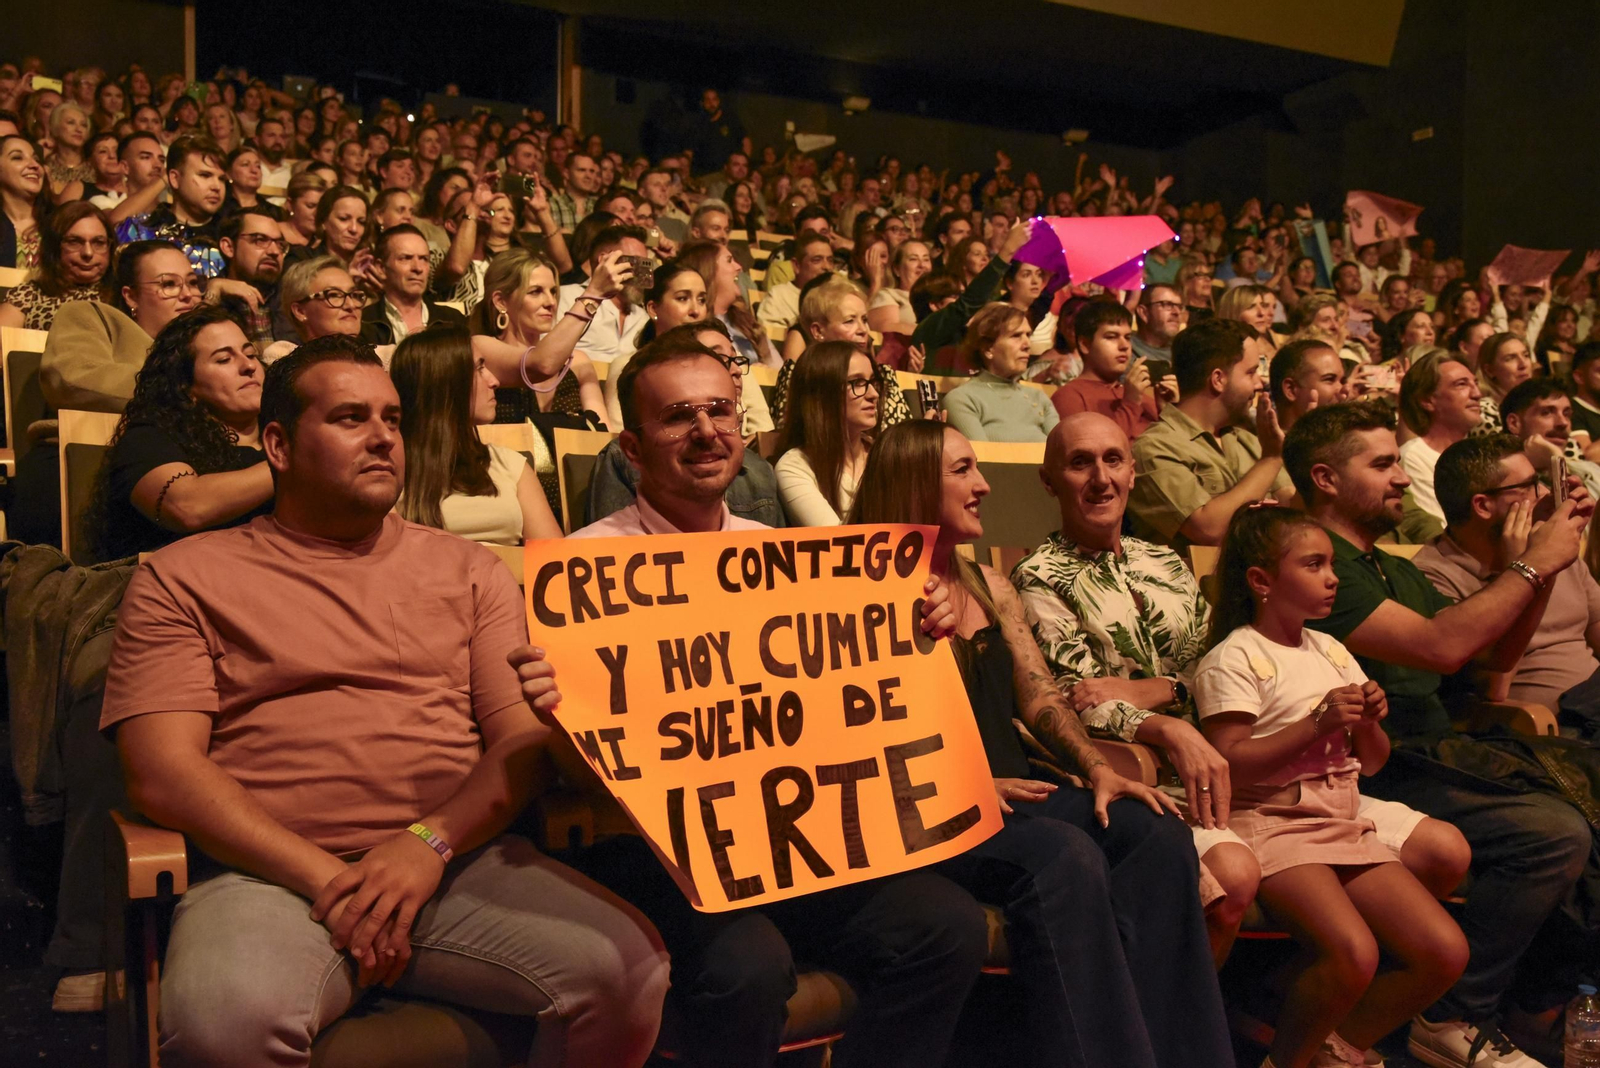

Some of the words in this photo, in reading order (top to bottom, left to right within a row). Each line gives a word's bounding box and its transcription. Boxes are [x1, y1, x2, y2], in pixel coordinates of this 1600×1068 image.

[532, 551, 689, 628] CRECI
[716, 530, 924, 593] CONTIGO
[595, 644, 628, 715] Y
[657, 631, 736, 693] HOY
[758, 597, 937, 679] CUMPLO
[573, 727, 642, 781] MI
[657, 682, 804, 761] SUEÑO
[842, 676, 907, 728] DE
[411, 825, 447, 852] OCIO
